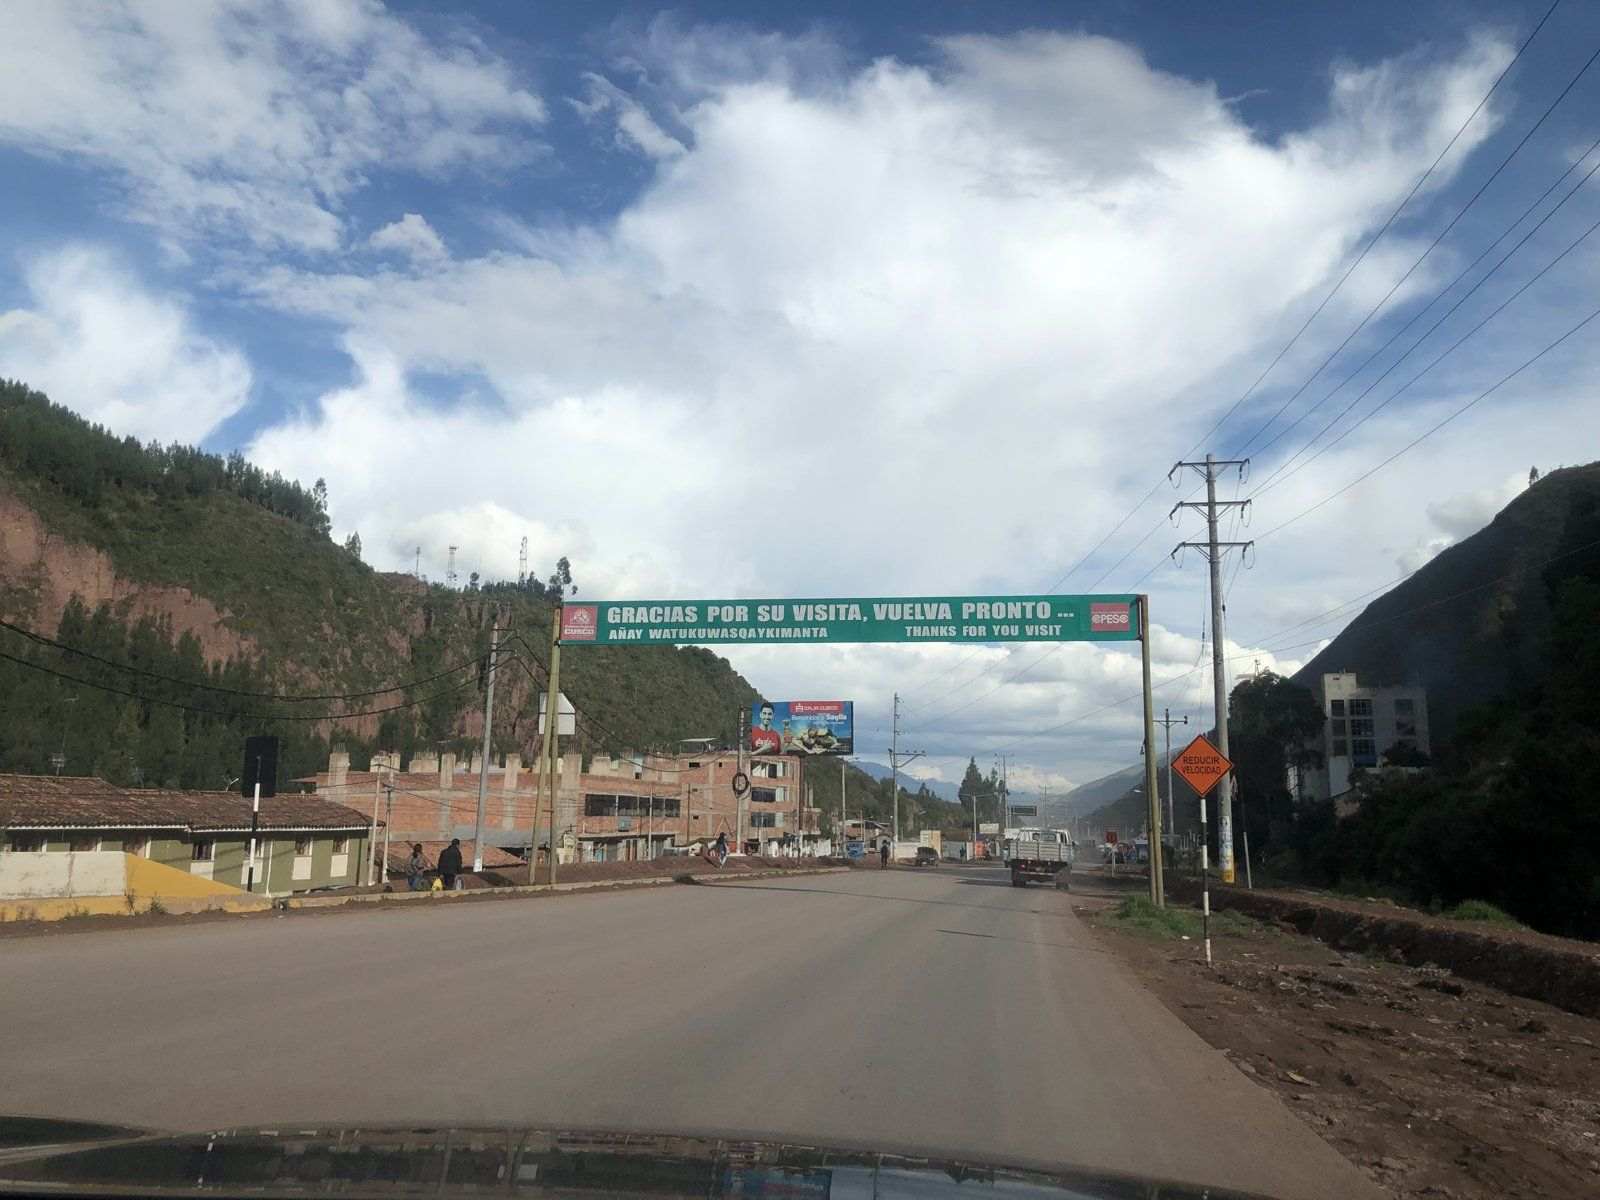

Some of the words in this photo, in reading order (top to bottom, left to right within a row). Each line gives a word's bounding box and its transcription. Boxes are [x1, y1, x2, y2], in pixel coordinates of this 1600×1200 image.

[607, 606, 698, 624] GRACIAS
[707, 605, 749, 623] POR
[757, 604, 785, 622] SU
[793, 604, 868, 622] VISITA,
[873, 603, 952, 621] VUELVA
[962, 602, 1051, 619] PRONTO
[608, 627, 643, 640] AÑAY
[905, 625, 957, 637] THANKS
[962, 625, 987, 636] FOR
[992, 625, 1019, 636] YOU
[1025, 625, 1062, 635] VISIT
[1183, 755, 1220, 764] REDUCIR
[1182, 765, 1221, 774] VELOCIDAD
